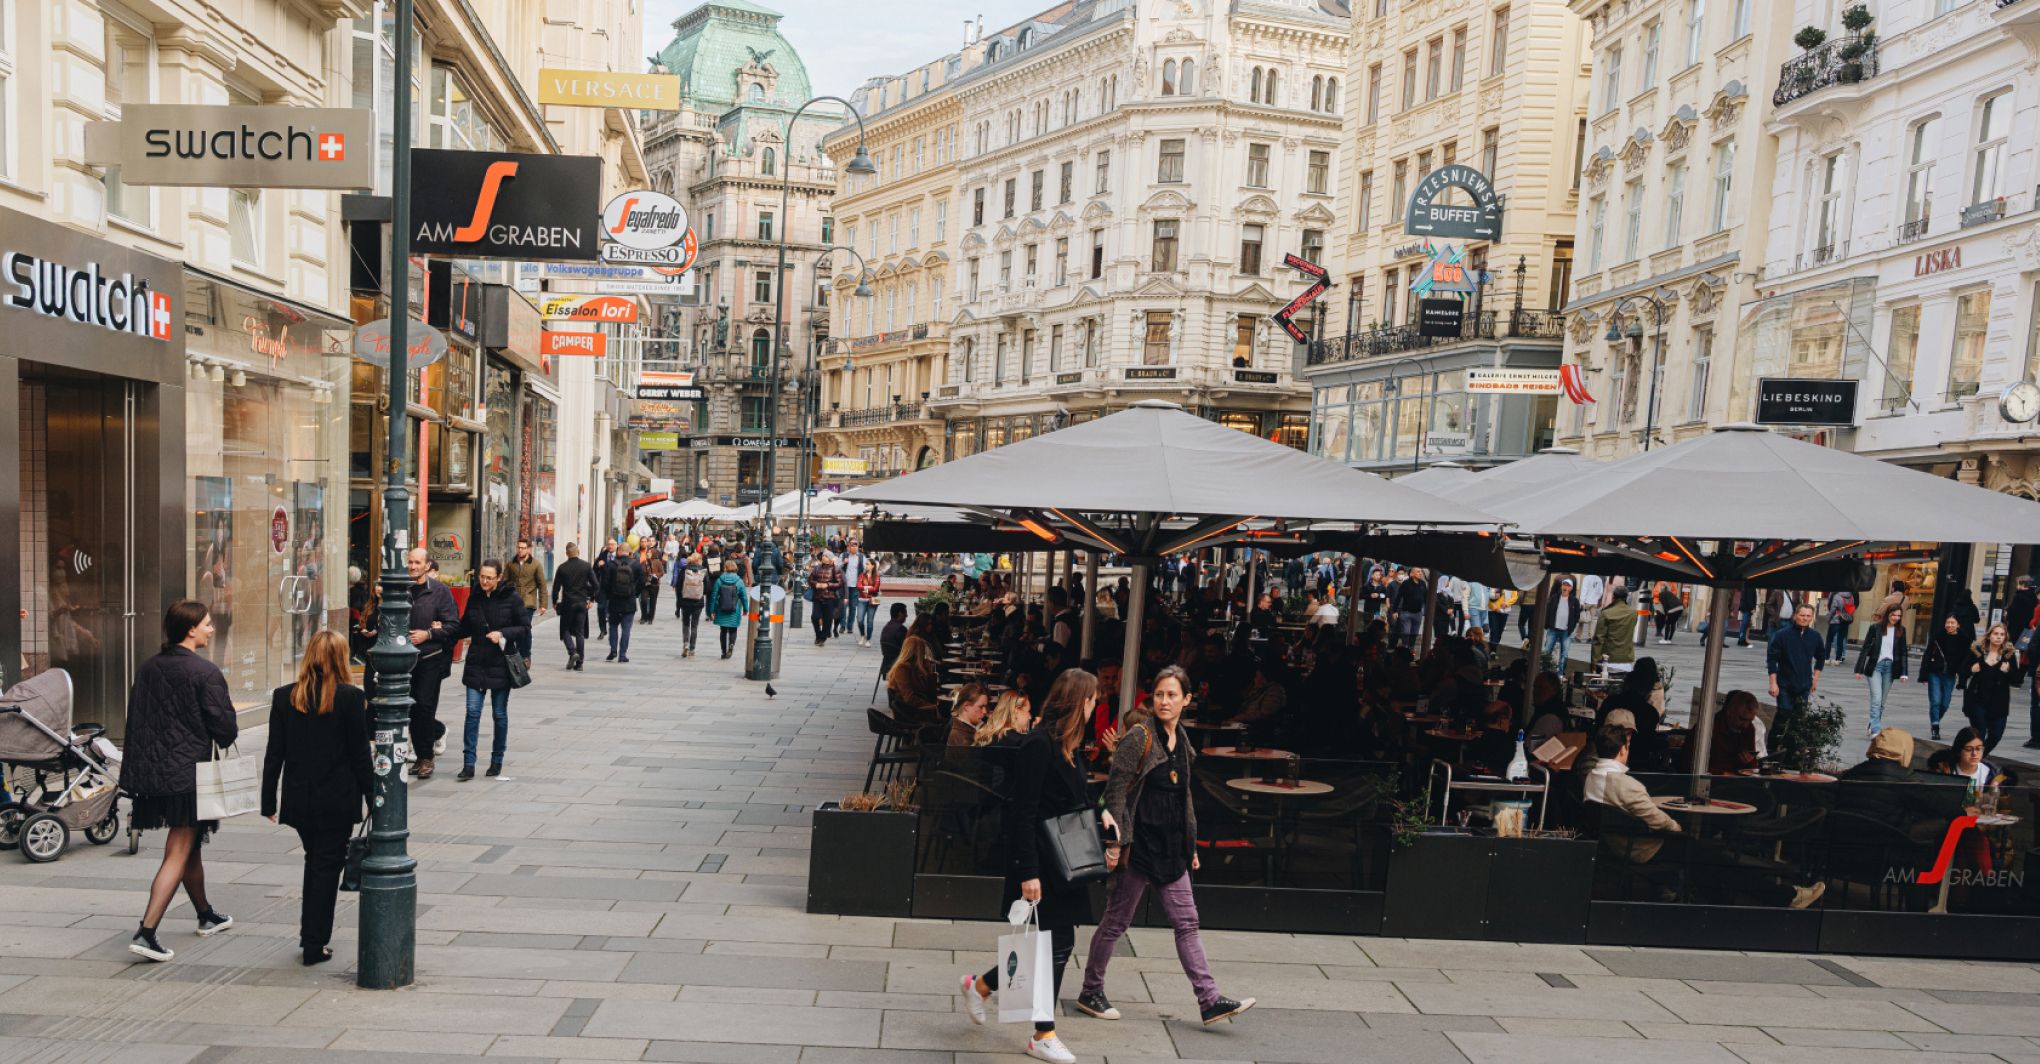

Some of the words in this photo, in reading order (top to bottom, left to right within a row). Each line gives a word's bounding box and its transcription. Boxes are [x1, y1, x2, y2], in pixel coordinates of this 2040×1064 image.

[554, 78, 665, 100] VERSACE
[145, 124, 313, 161] swatch
[610, 198, 681, 233] Segafredo
[1430, 208, 1480, 223] BUFFET
[416, 221, 455, 243] AM
[489, 223, 582, 248] GRABEN
[609, 246, 679, 262] ESPRESSO
[1914, 245, 1962, 278] LISKA
[3, 252, 152, 336] swatch
[546, 303, 598, 317] Eissalon
[552, 335, 593, 352] CAMPER
[639, 389, 669, 398] GERRY
[671, 389, 702, 398] WEBER
[1763, 393, 1842, 403] LIEBESKIND
[1882, 865, 1916, 884] AM
[1949, 868, 2025, 888] GRABEN
